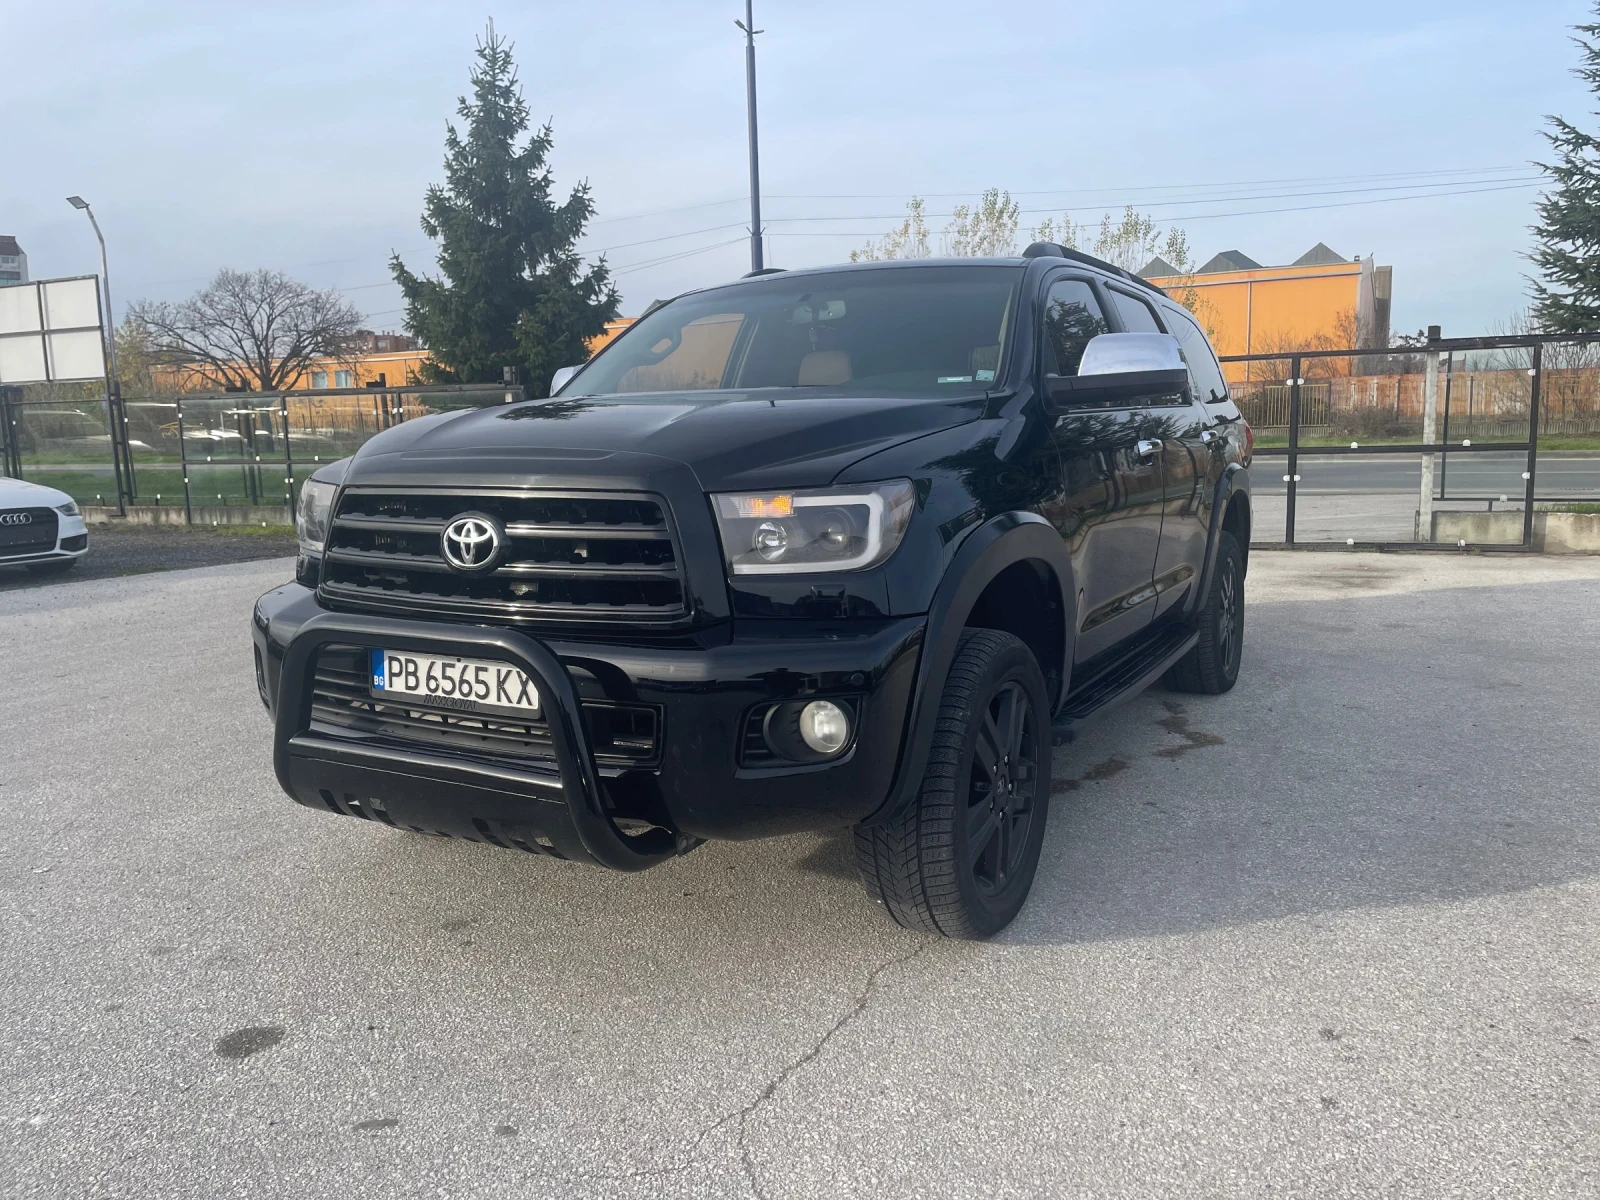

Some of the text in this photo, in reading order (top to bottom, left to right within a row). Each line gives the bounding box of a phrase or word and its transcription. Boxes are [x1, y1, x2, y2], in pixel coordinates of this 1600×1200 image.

[373, 675, 384, 686] BG
[387, 655, 534, 707] PB 6565 KX
